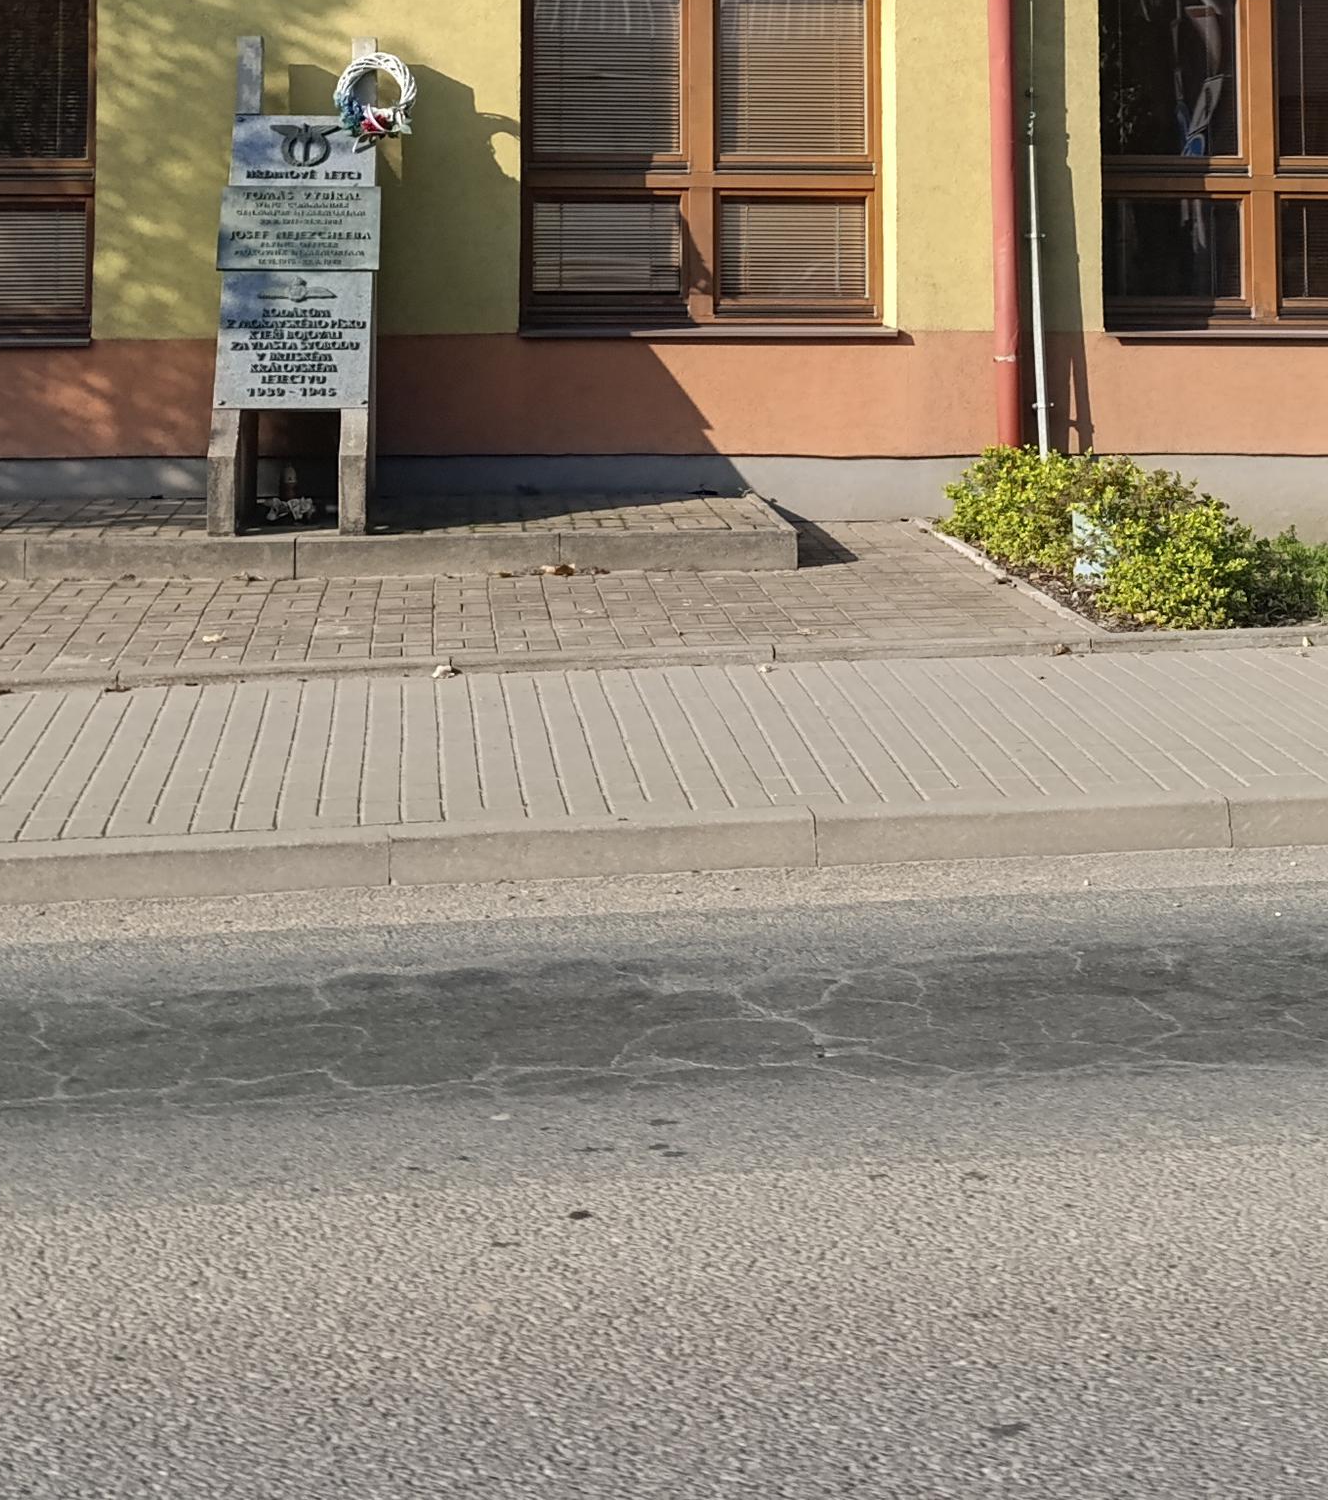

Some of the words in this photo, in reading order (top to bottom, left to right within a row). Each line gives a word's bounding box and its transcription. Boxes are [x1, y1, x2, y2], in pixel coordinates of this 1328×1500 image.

[230, 231, 270, 241] JOSEF
[247, 387, 286, 397] 1939
[299, 387, 338, 397] 1945
